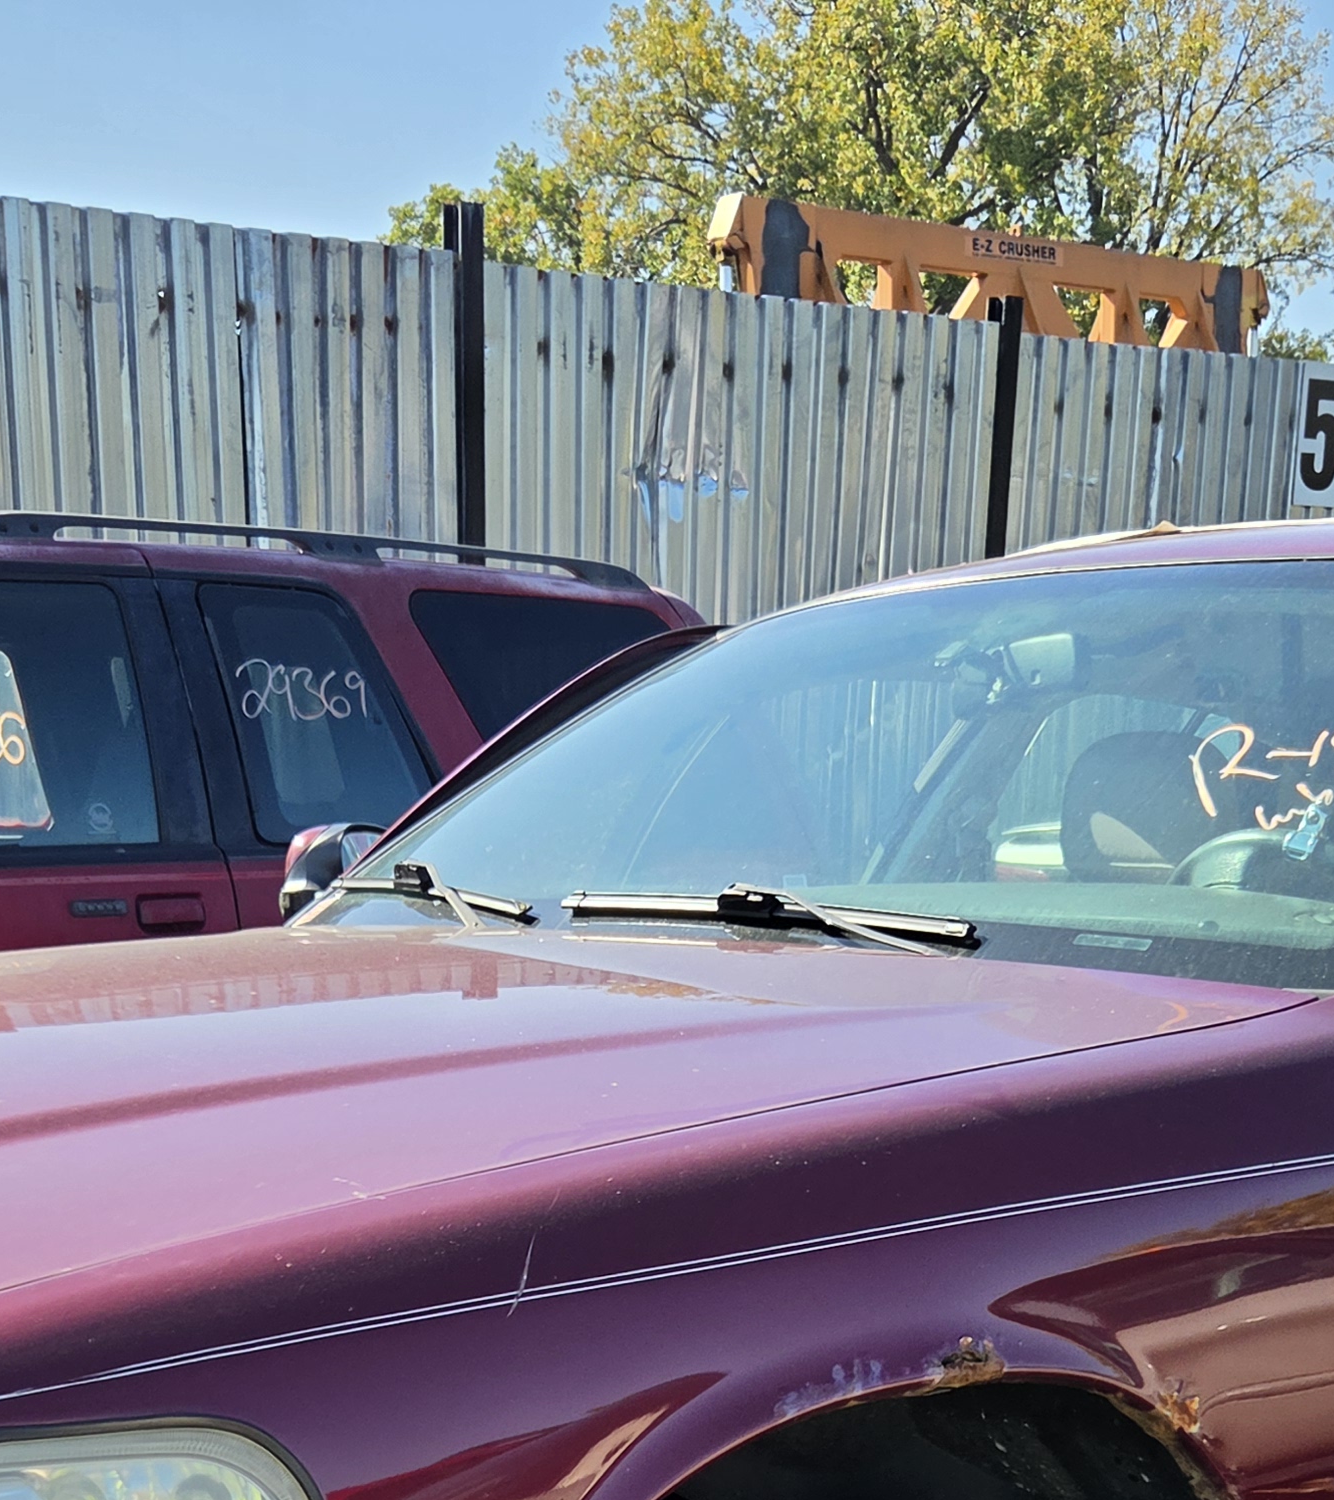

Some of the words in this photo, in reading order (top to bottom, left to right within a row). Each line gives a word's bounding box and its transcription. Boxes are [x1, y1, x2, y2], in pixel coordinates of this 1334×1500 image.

[972, 238, 993, 253] E-Z
[998, 240, 1056, 260] CRUSHER
[235, 658, 368, 721] 29369
